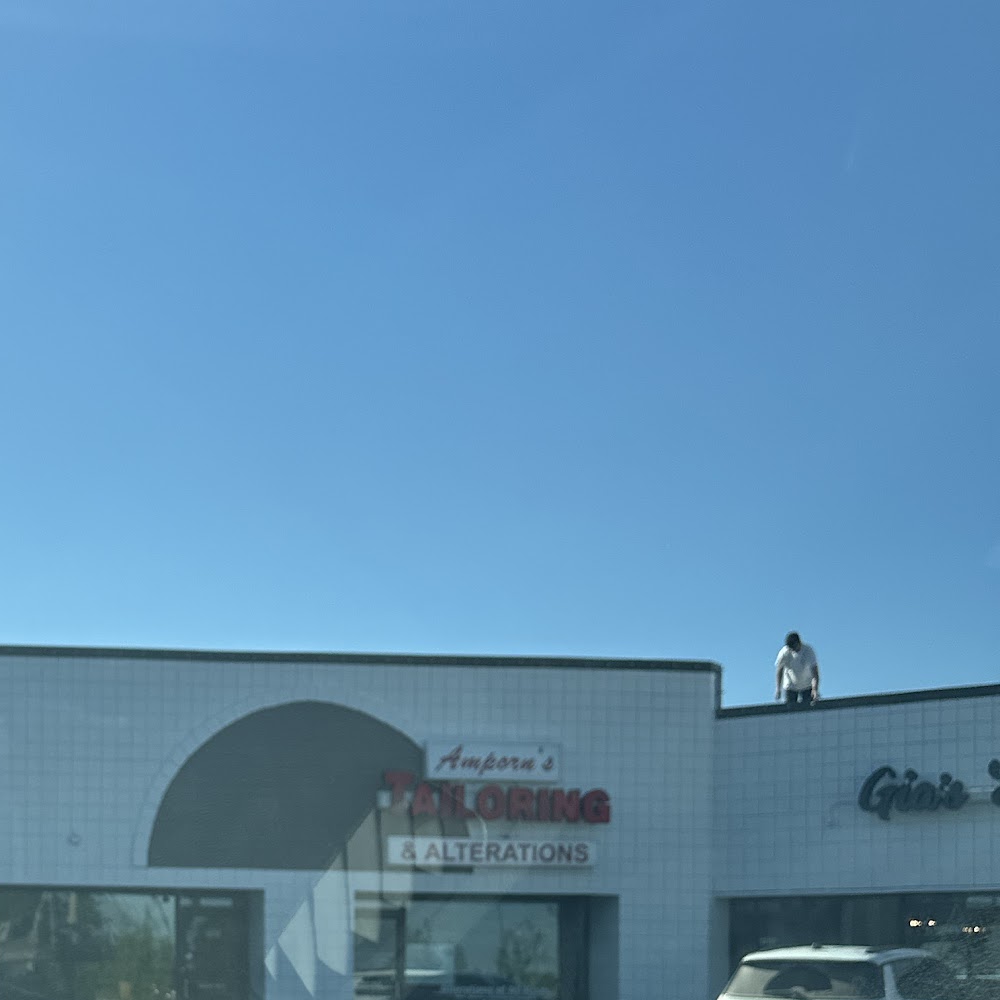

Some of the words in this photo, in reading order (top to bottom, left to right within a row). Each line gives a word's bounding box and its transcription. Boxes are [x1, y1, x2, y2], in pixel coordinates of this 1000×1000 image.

[434, 744, 554, 774] Amporn's
[384, 770, 612, 824] TAILORING
[401, 841, 417, 861] &
[424, 842, 590, 864] ALTERATIONS
